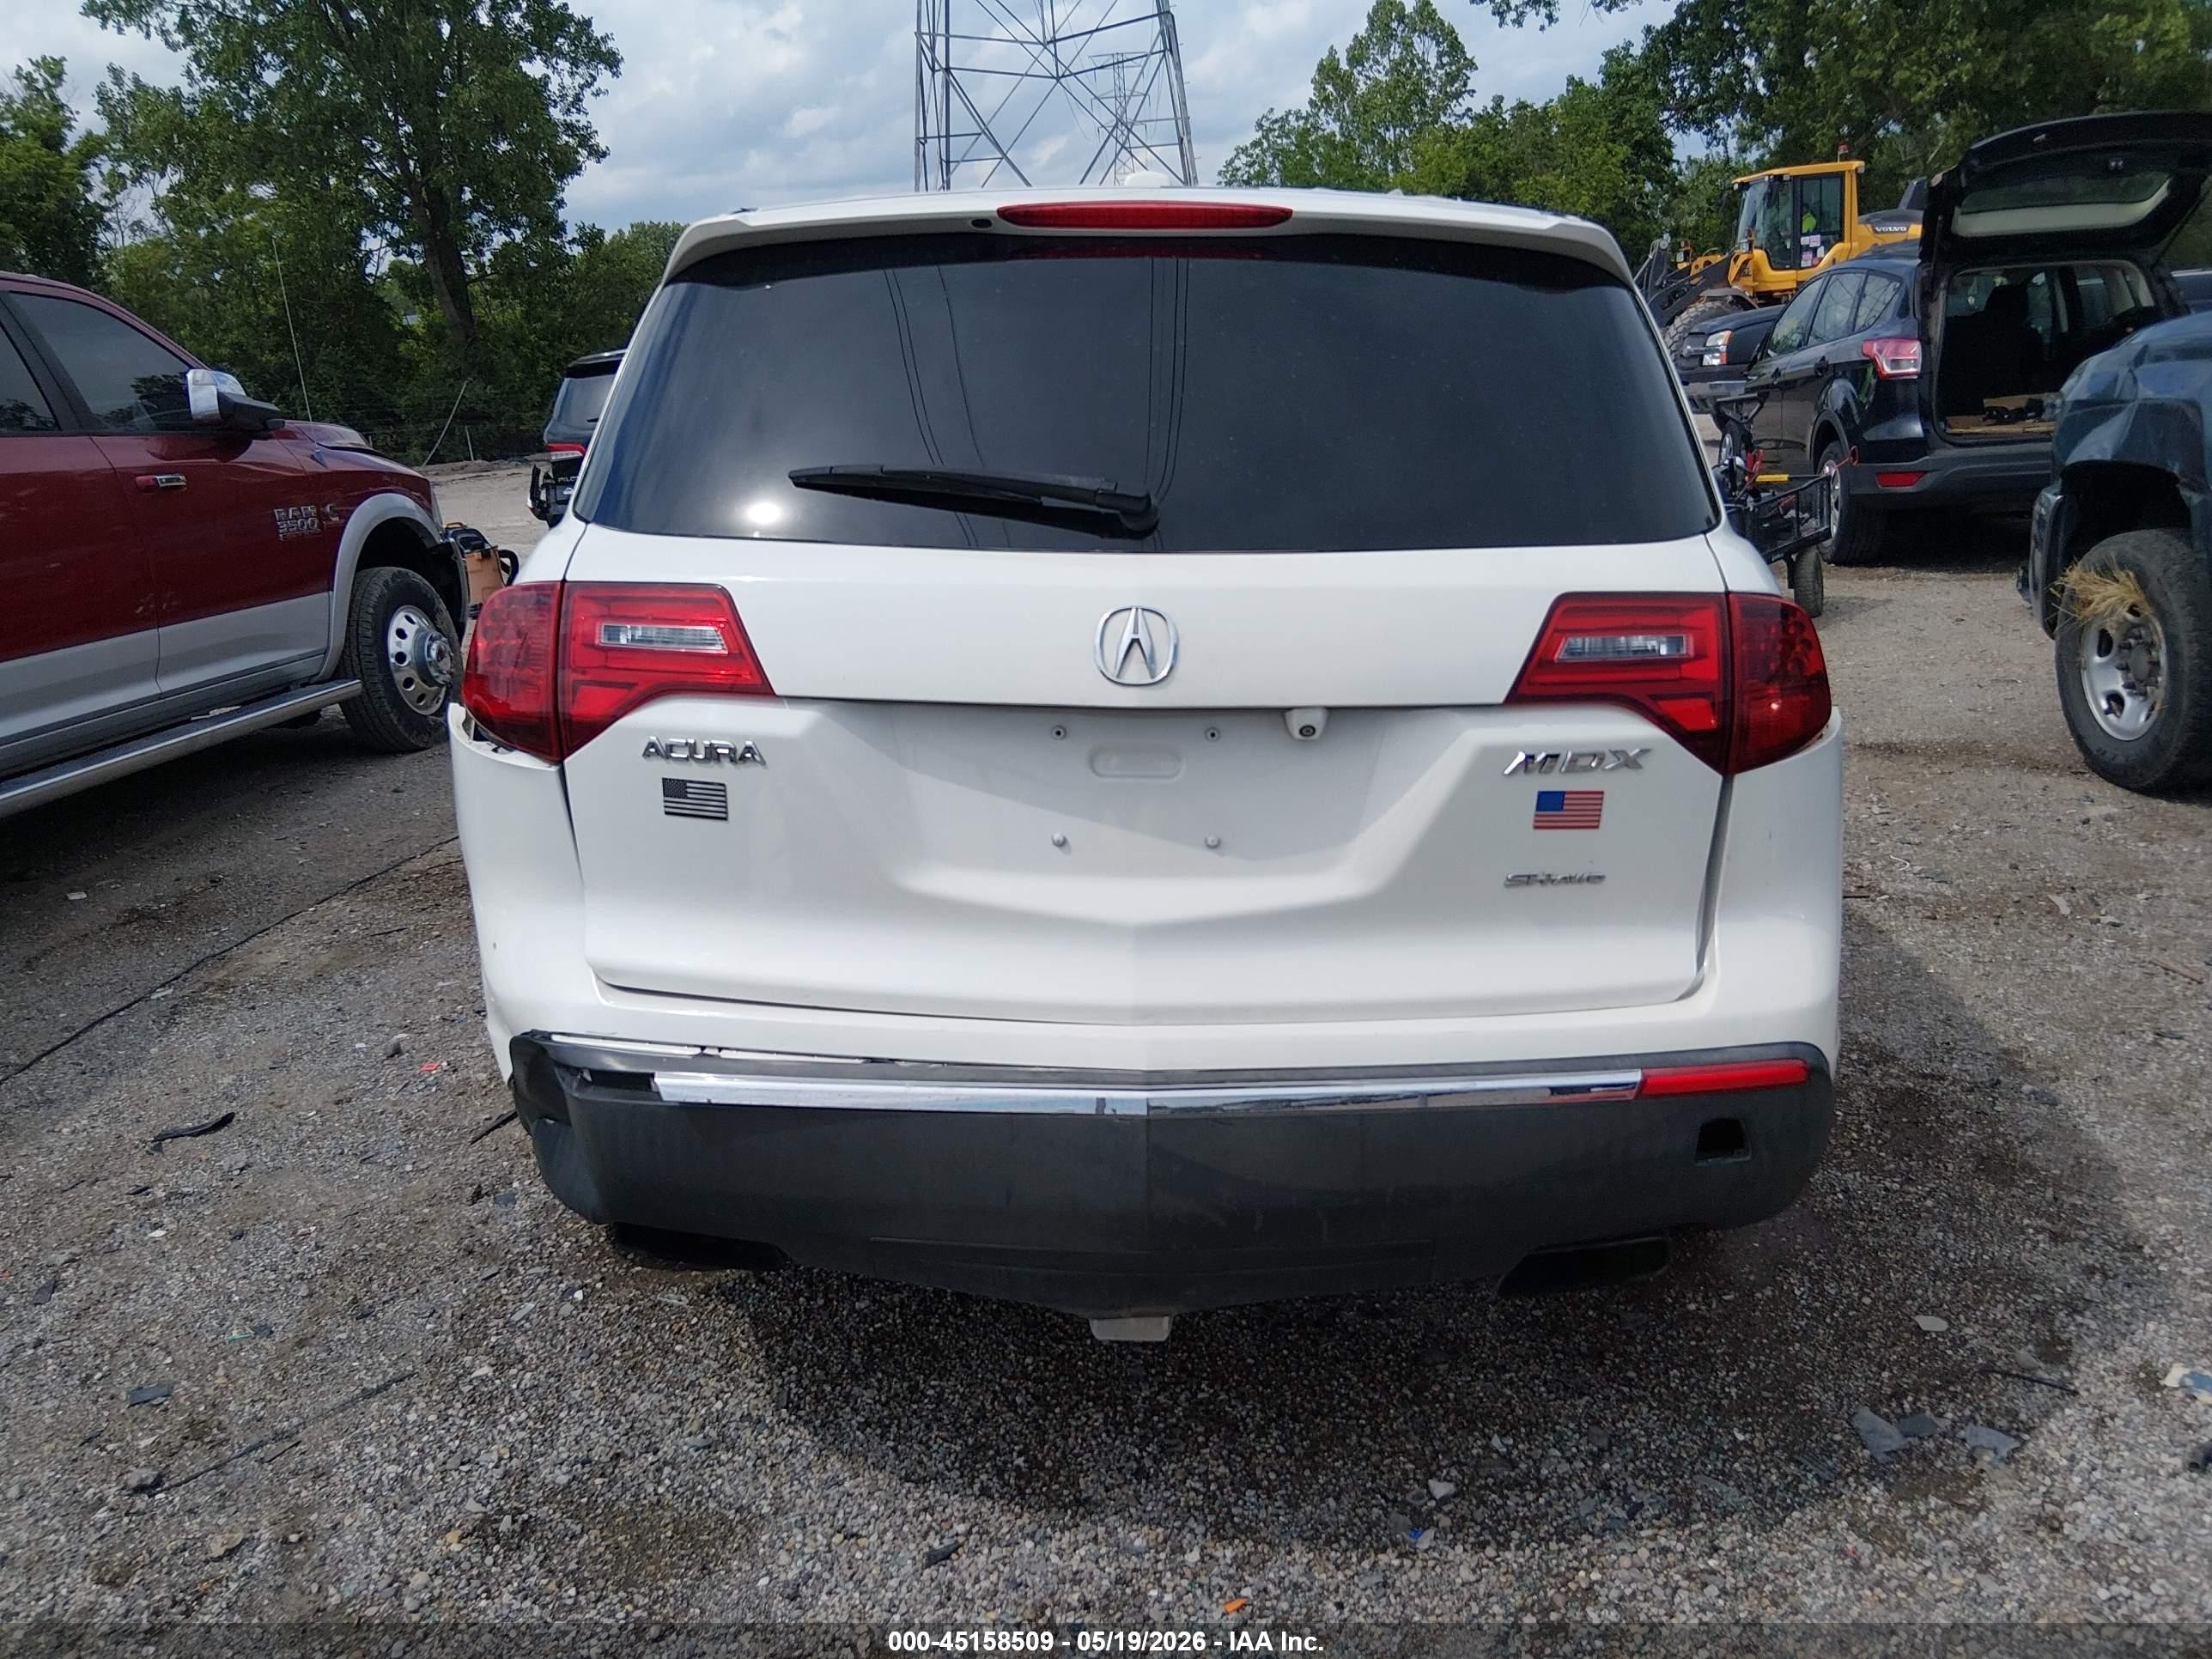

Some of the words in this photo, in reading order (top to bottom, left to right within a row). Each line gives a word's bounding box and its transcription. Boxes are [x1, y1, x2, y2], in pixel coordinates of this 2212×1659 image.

[274, 505, 317, 520] RAM
[642, 735, 768, 767] ACURA
[1504, 748, 1653, 775] MDX
